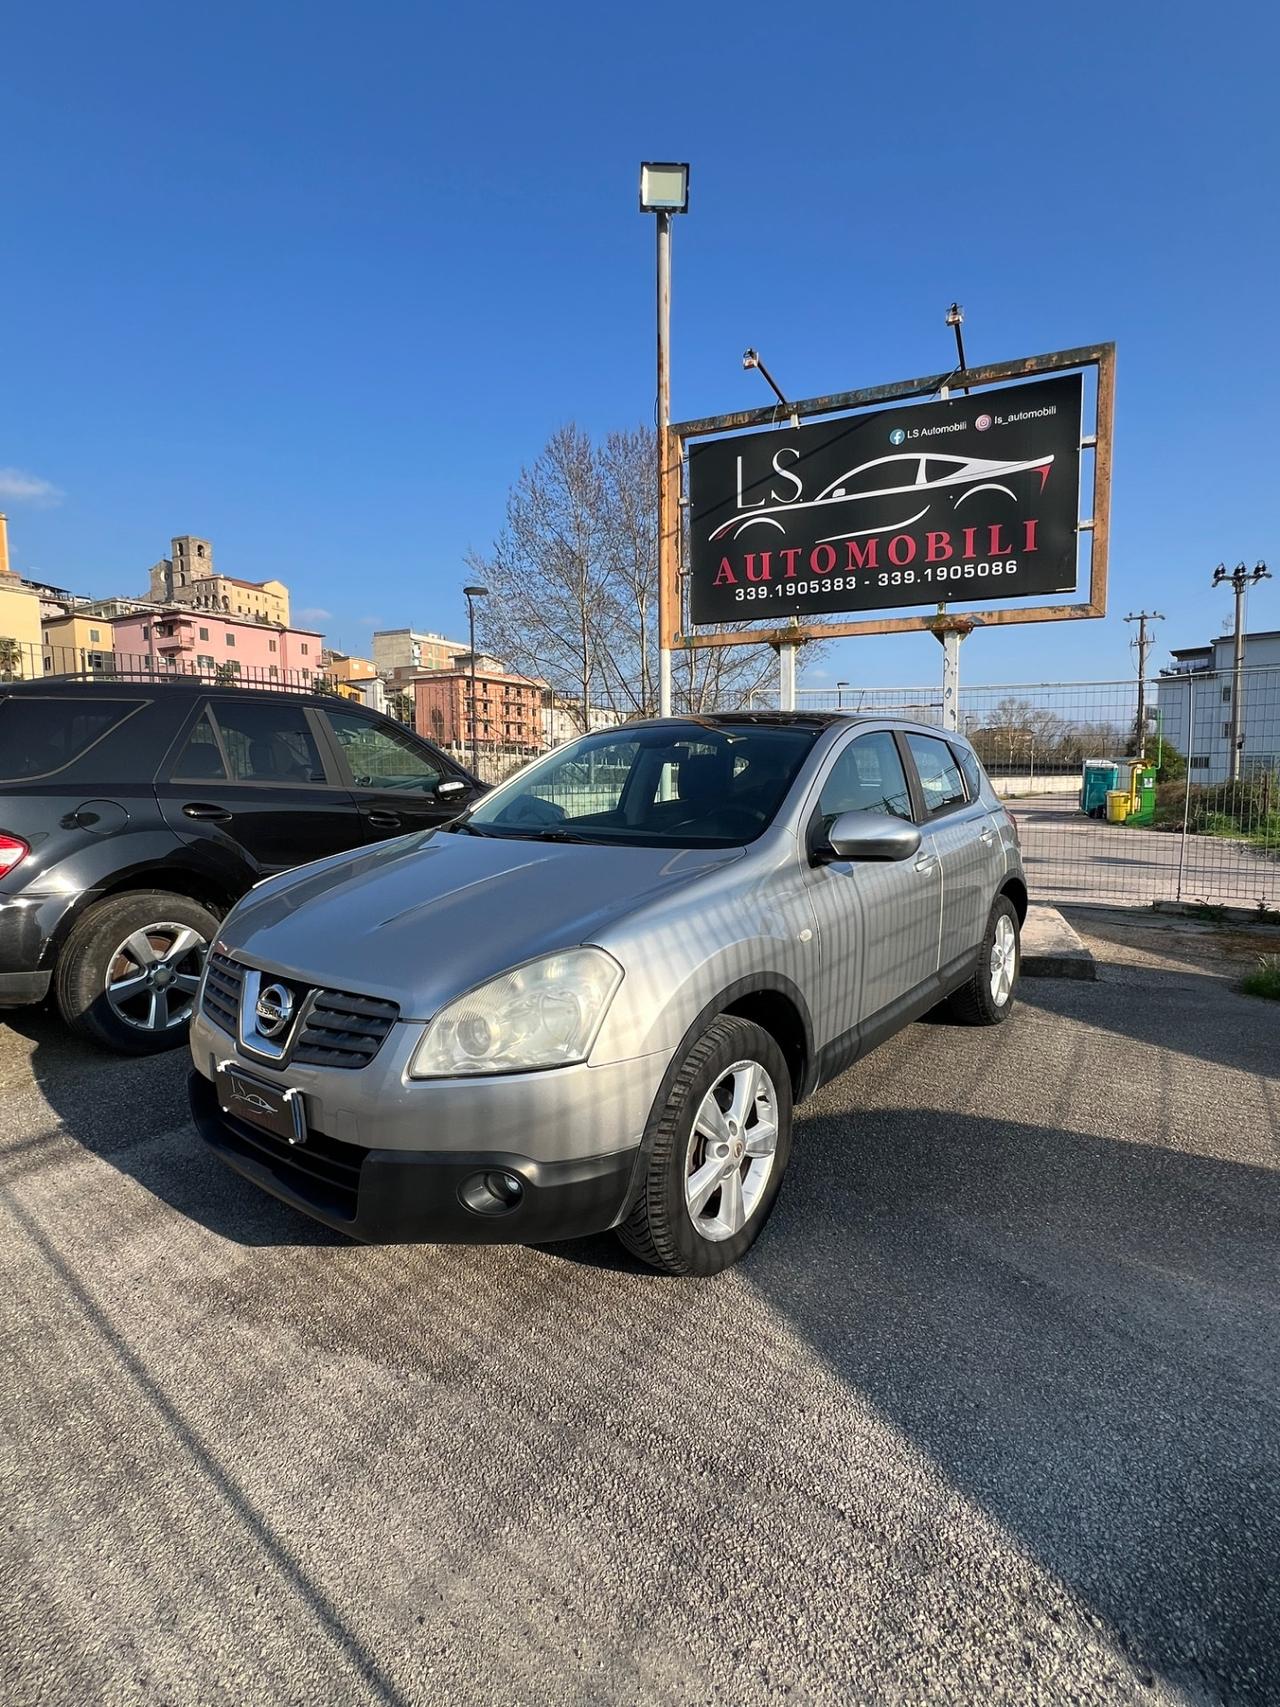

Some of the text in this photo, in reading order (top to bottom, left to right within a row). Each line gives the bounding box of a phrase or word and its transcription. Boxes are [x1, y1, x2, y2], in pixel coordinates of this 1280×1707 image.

[907, 421, 967, 439] LS Automobili
[994, 405, 1057, 425] ls_automobili
[712, 520, 1039, 585] AUTOMOBILI
[735, 576, 856, 601] 339.1905383
[878, 560, 1018, 587] 339.1905086
